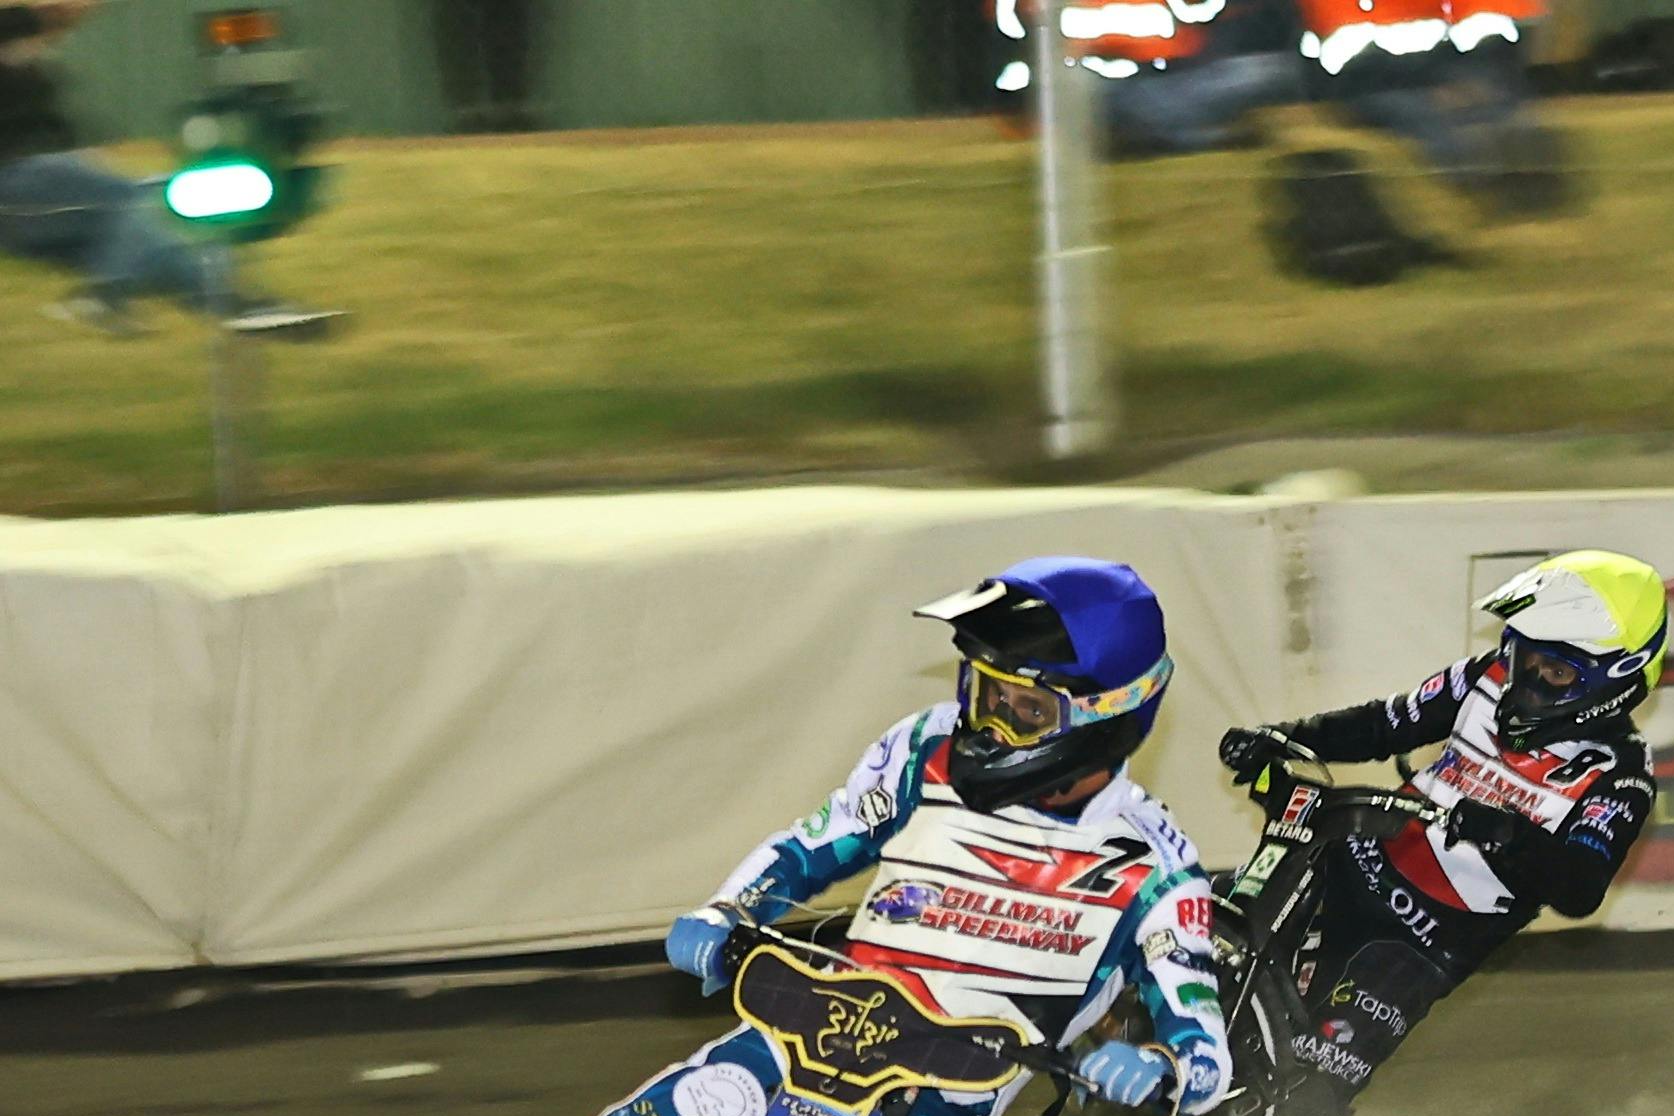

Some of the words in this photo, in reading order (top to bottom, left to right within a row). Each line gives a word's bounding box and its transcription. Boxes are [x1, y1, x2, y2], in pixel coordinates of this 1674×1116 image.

[1544, 748, 1616, 786] 8
[1056, 836, 1153, 893] 2
[919, 905, 1096, 956] SPEEDWAY
[941, 885, 1083, 932] GILLMAN
